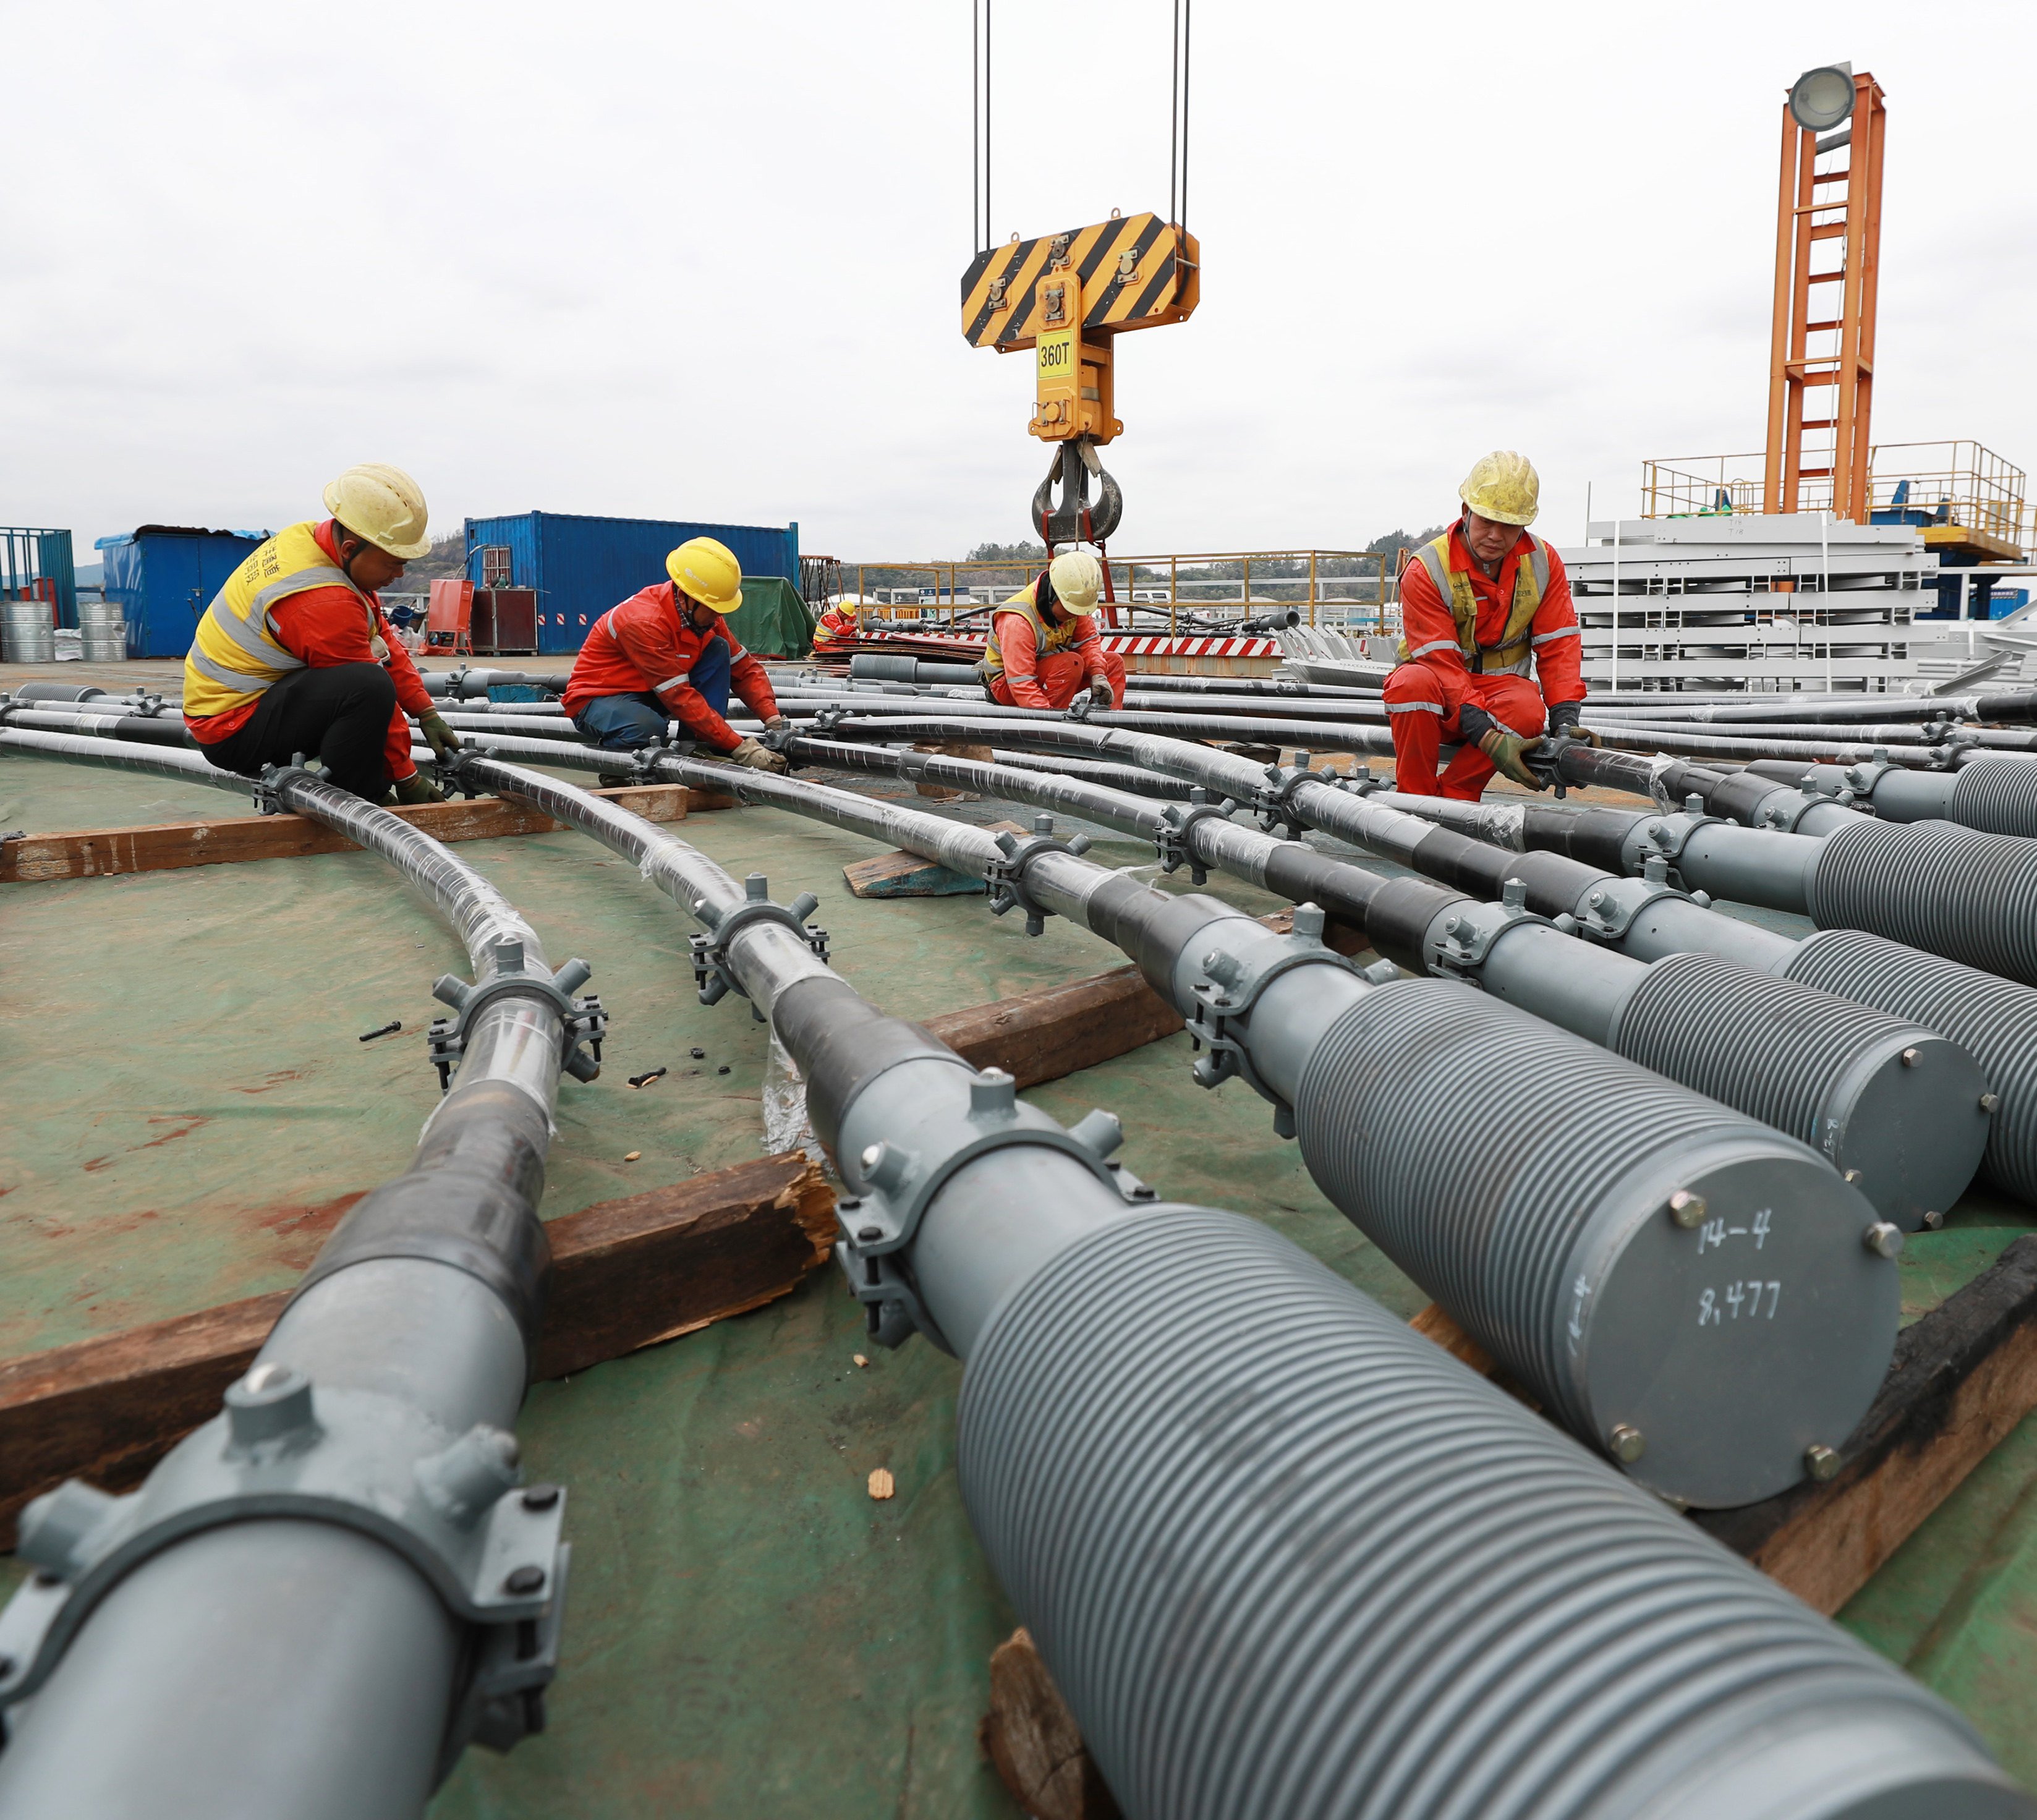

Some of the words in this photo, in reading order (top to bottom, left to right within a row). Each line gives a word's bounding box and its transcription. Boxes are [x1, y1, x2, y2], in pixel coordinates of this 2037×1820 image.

[1041, 342, 1070, 367] 360T
[1698, 1207, 1772, 1255] 14-4
[1698, 1280, 1781, 1326] 8,477
